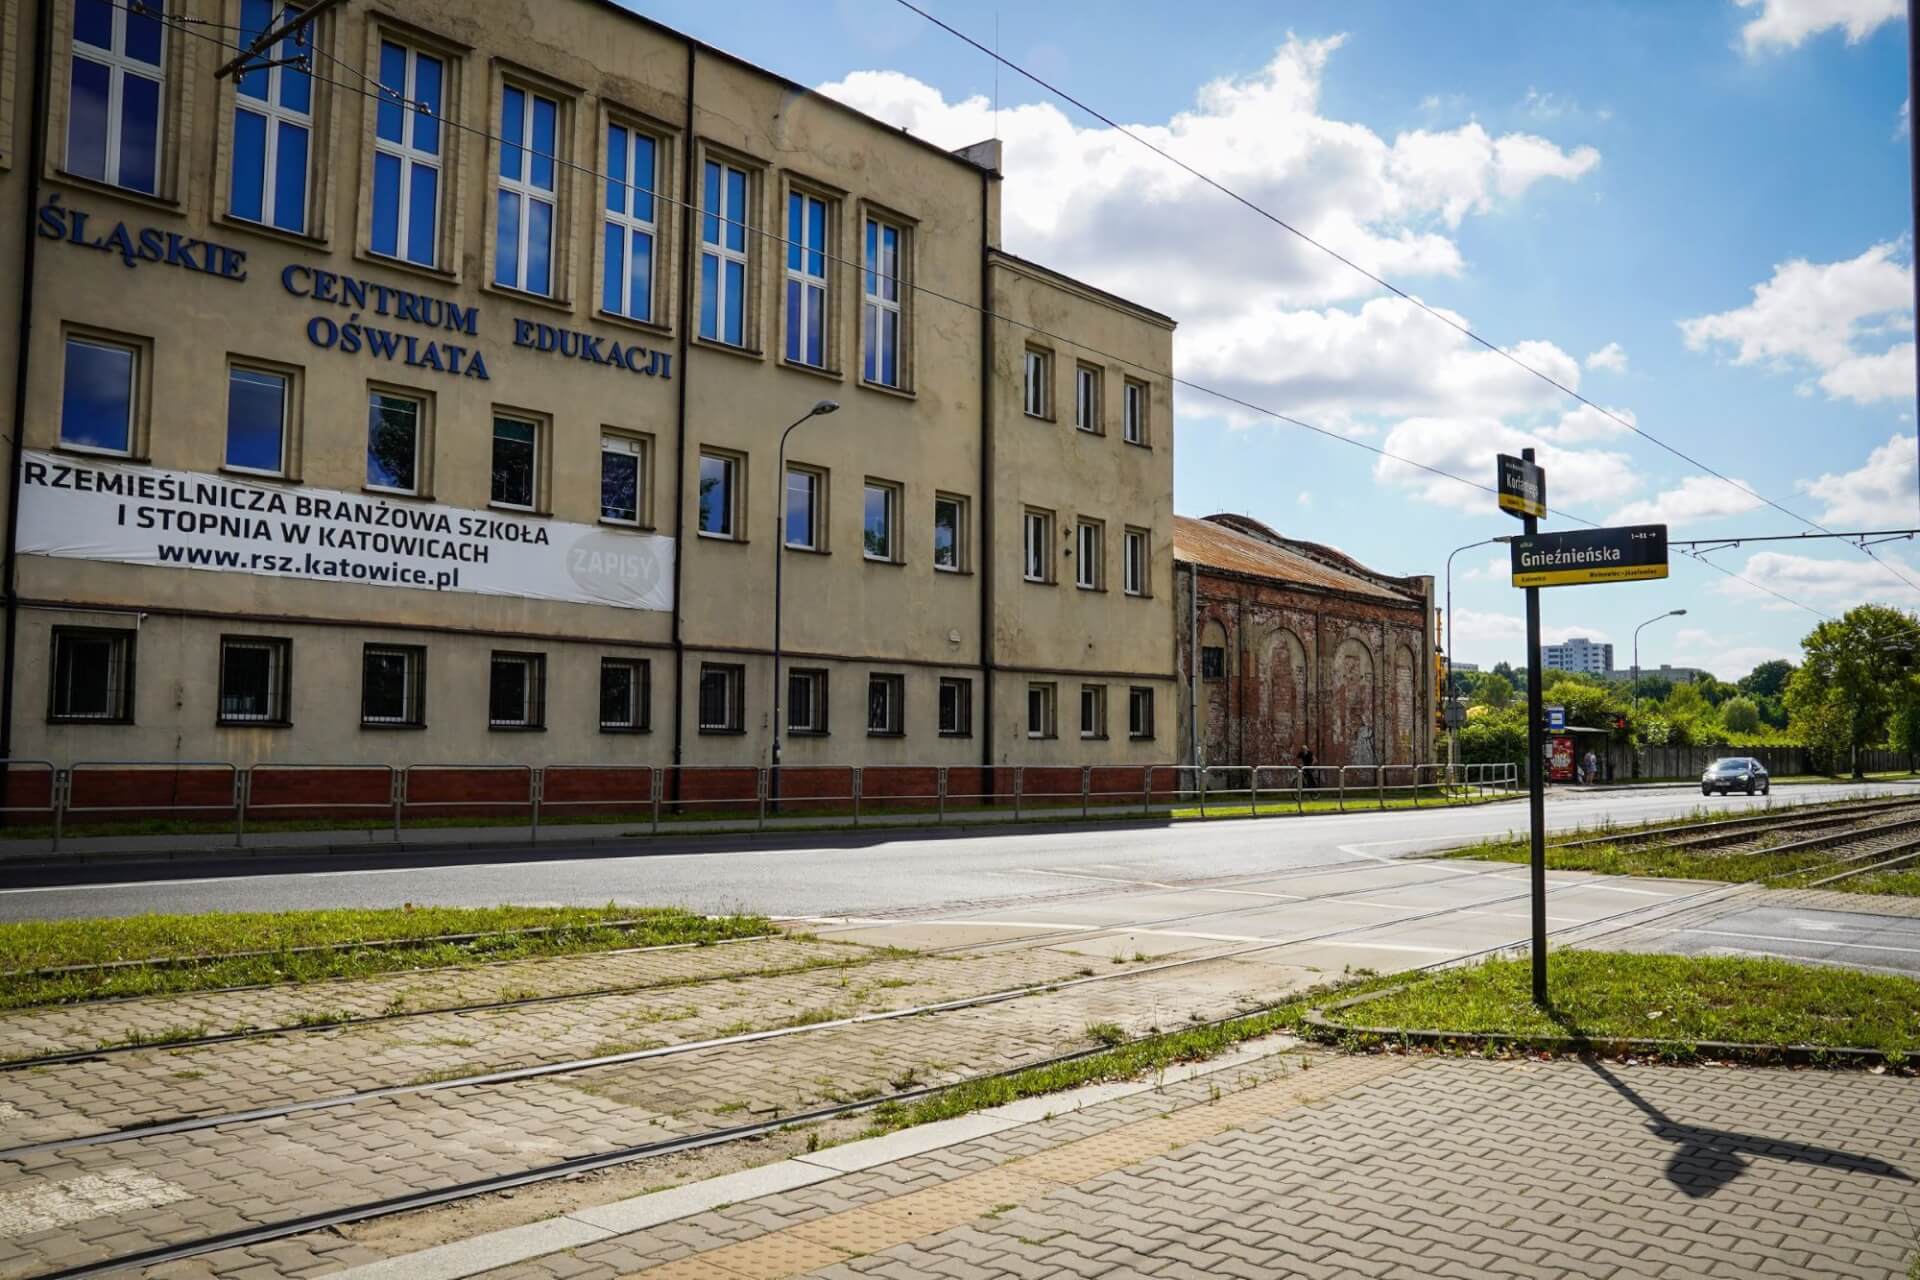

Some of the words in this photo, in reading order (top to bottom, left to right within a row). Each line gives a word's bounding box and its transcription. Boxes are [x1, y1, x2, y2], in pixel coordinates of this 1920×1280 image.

[38, 193, 248, 282] ŚLĄSKIE
[281, 263, 480, 336] CENTRUM
[513, 317, 672, 380] EDUKACJI
[306, 313, 490, 381] OŚWIATA
[24, 461, 287, 515] RZEMIEŚLNICZA
[295, 495, 452, 534] BRANŻOWA
[458, 516, 550, 546] SZKOŁA
[117, 503, 126, 526] I
[137, 505, 272, 541] STOPNIA
[281, 521, 311, 545] W
[319, 526, 489, 564] KATOWICACH
[157, 544, 460, 592] www.rsz.katowice.pl
[573, 548, 654, 580] ZAPISY
[1520, 545, 1621, 567] Gnieźnieńska
